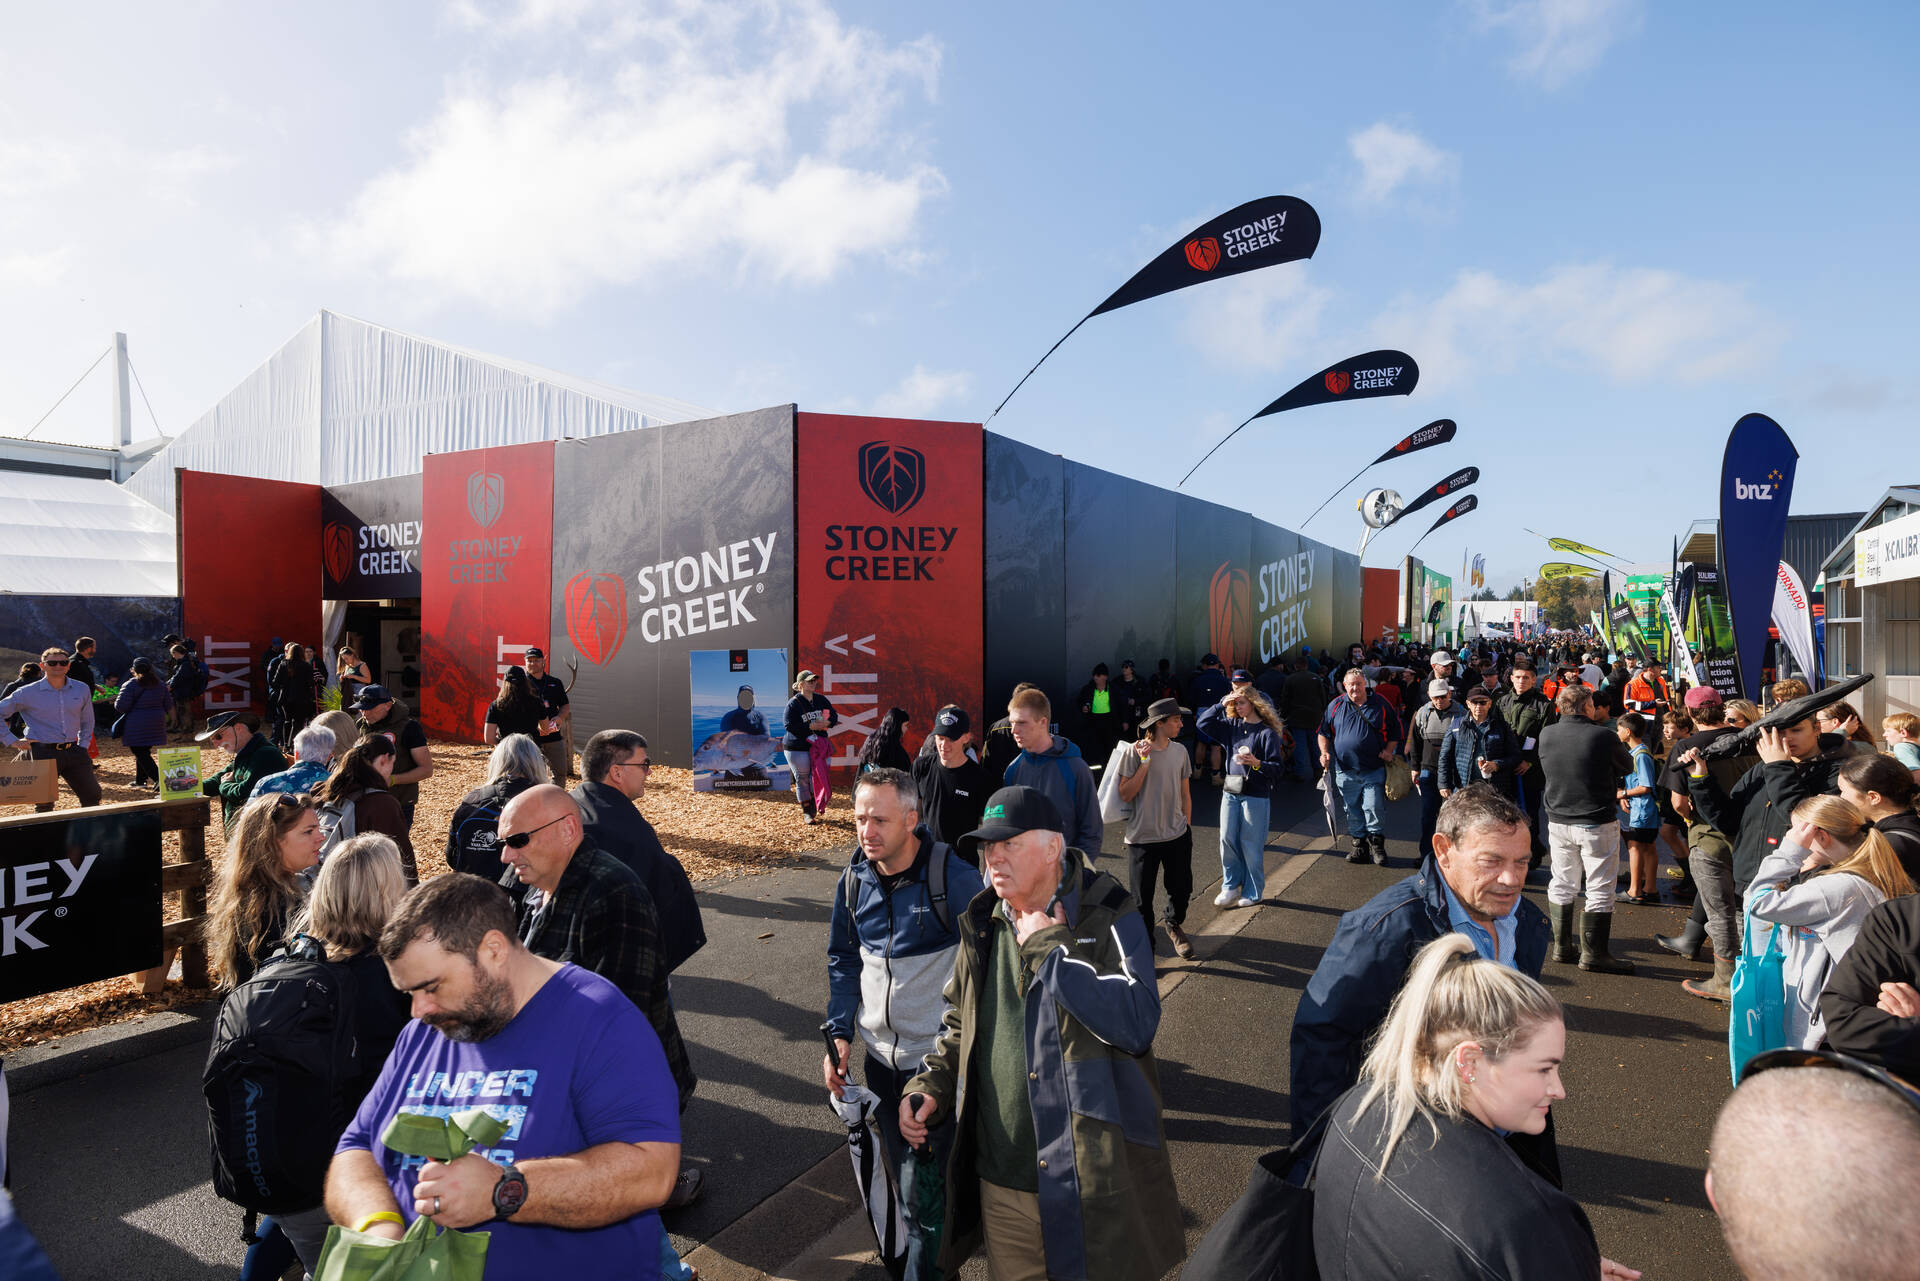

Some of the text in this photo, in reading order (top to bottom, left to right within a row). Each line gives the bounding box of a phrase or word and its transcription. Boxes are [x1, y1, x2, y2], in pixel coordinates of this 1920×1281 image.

[1222, 210, 1288, 246] STONEY
[1227, 229, 1282, 258] CREEK
[1353, 366, 1404, 381] STONEY
[1353, 377, 1395, 390] CREEK
[1412, 424, 1445, 442] STONEY
[1413, 433, 1439, 446] CREEK
[1449, 470, 1473, 486] STONEY
[1735, 477, 1773, 500] bnz
[358, 520, 423, 550] STONEY
[448, 535, 523, 562] STONEY
[824, 524, 959, 552] STONEY
[637, 531, 778, 604] STONEY
[1258, 549, 1315, 613] STONEY
[204, 635, 251, 710] EXIT
[1715, 657, 1735, 666] steel
[1714, 677, 1735, 686] build
[163, 763, 198, 778] WIN
[405, 1069, 539, 1098] UNDER
[245, 1108, 272, 1198] macpac
